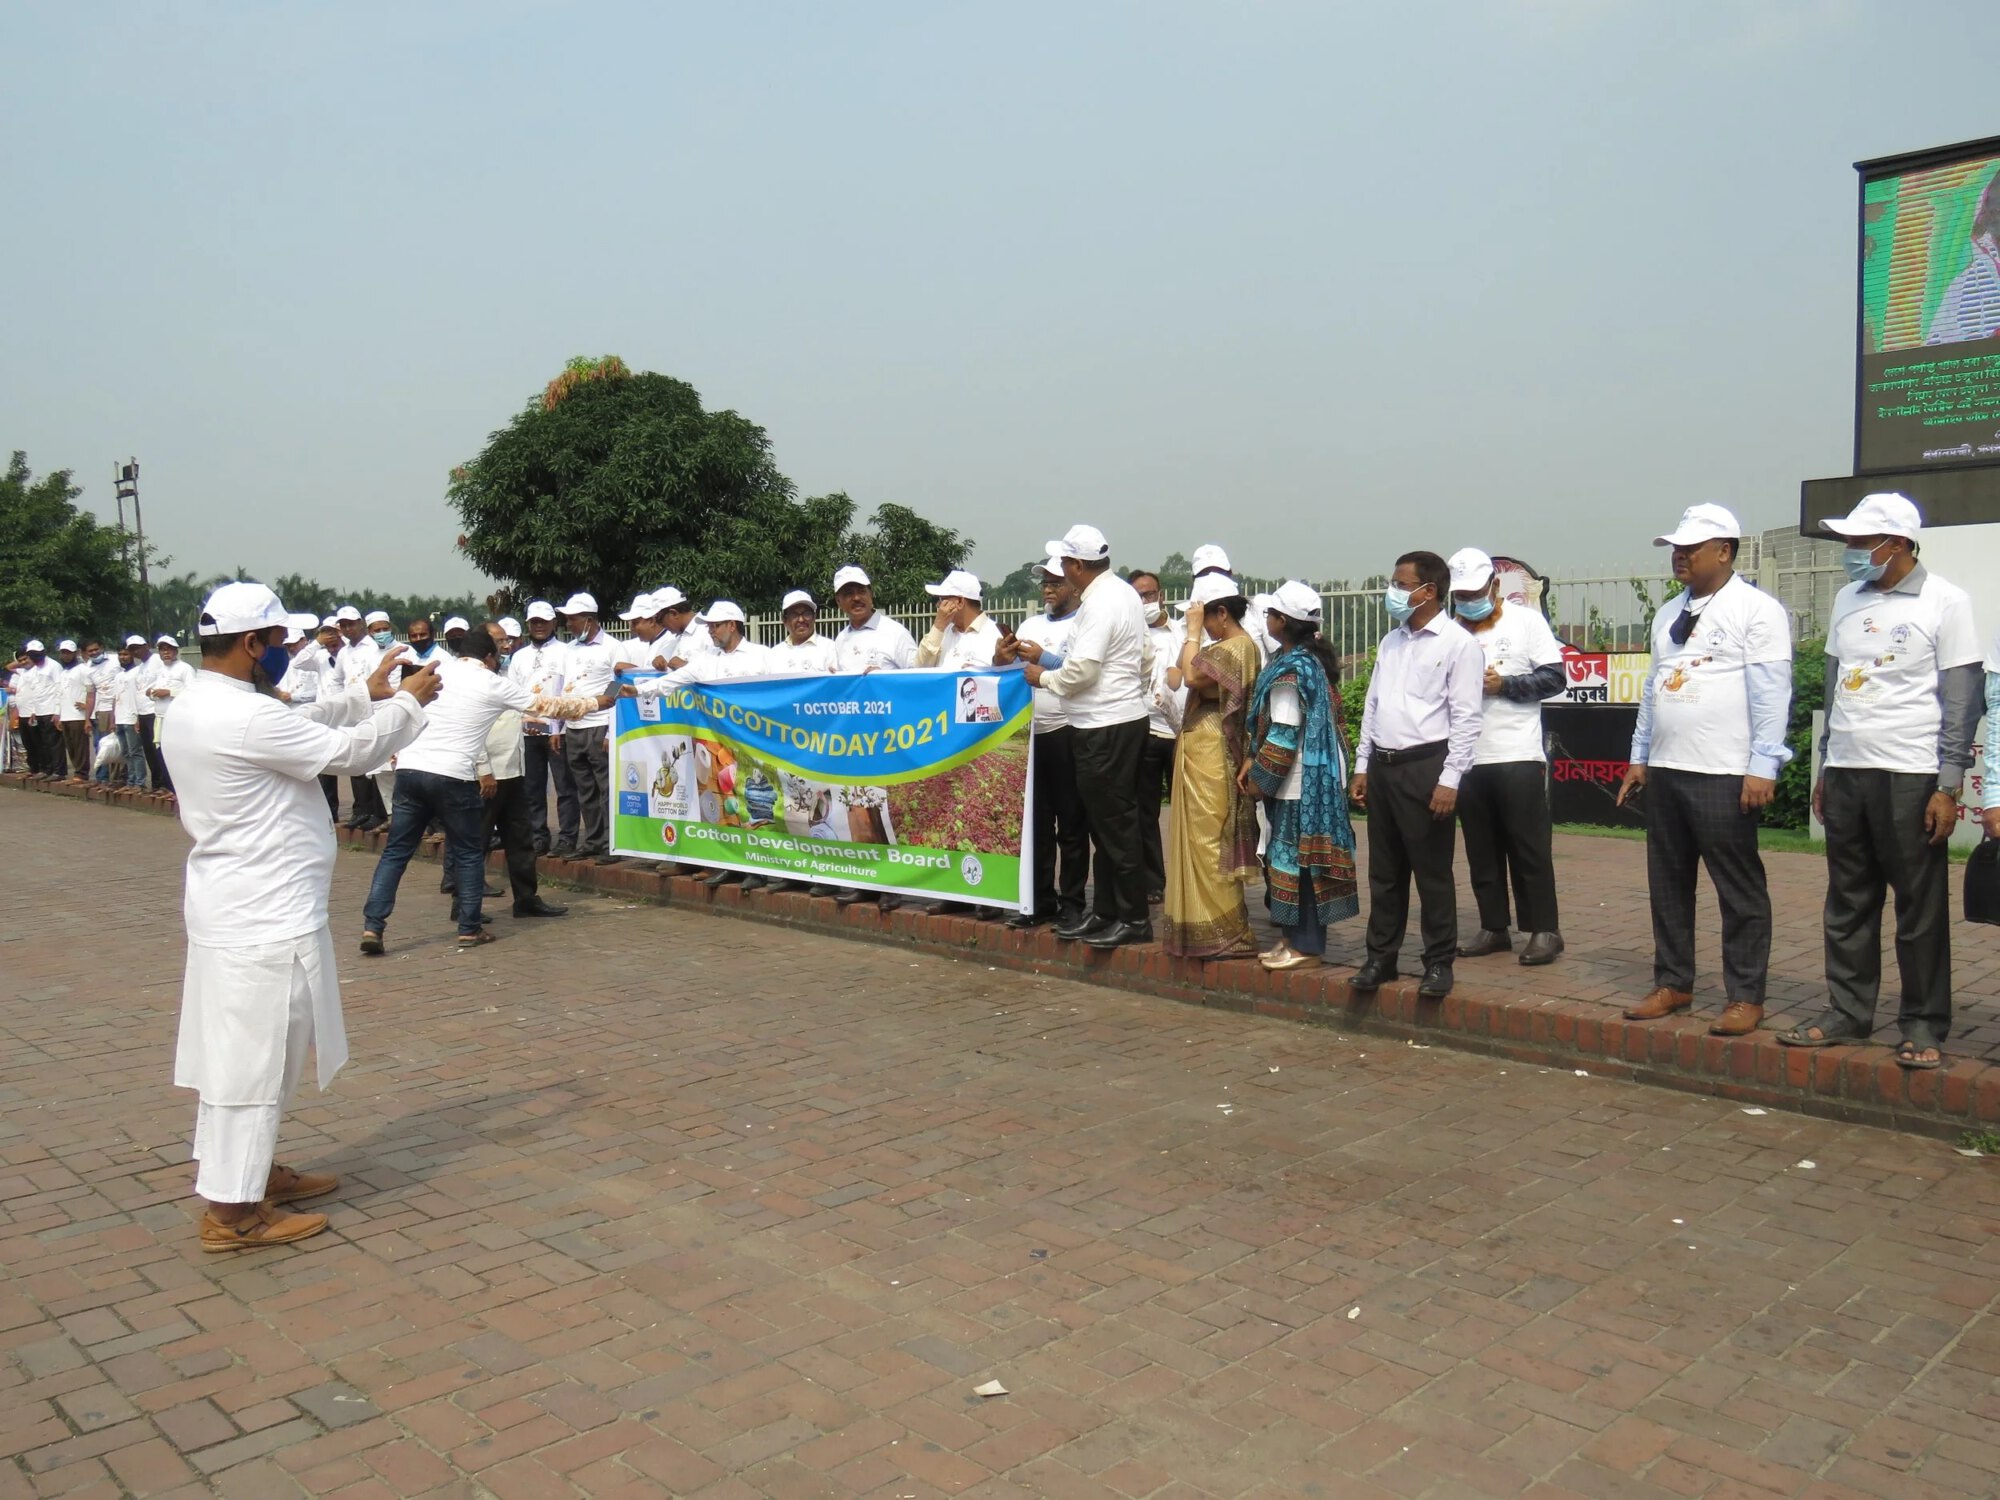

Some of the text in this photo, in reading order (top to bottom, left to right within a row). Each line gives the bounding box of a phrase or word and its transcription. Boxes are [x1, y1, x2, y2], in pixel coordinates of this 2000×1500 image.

[793, 700, 892, 715] 7 OCTOBER 2021
[665, 689, 948, 756] WORLD COTTON DAY 2021
[657, 807, 677, 815] COTTON
[684, 825, 951, 869] Cotton Development Board
[745, 851, 877, 878] Ministry of Agriculture
